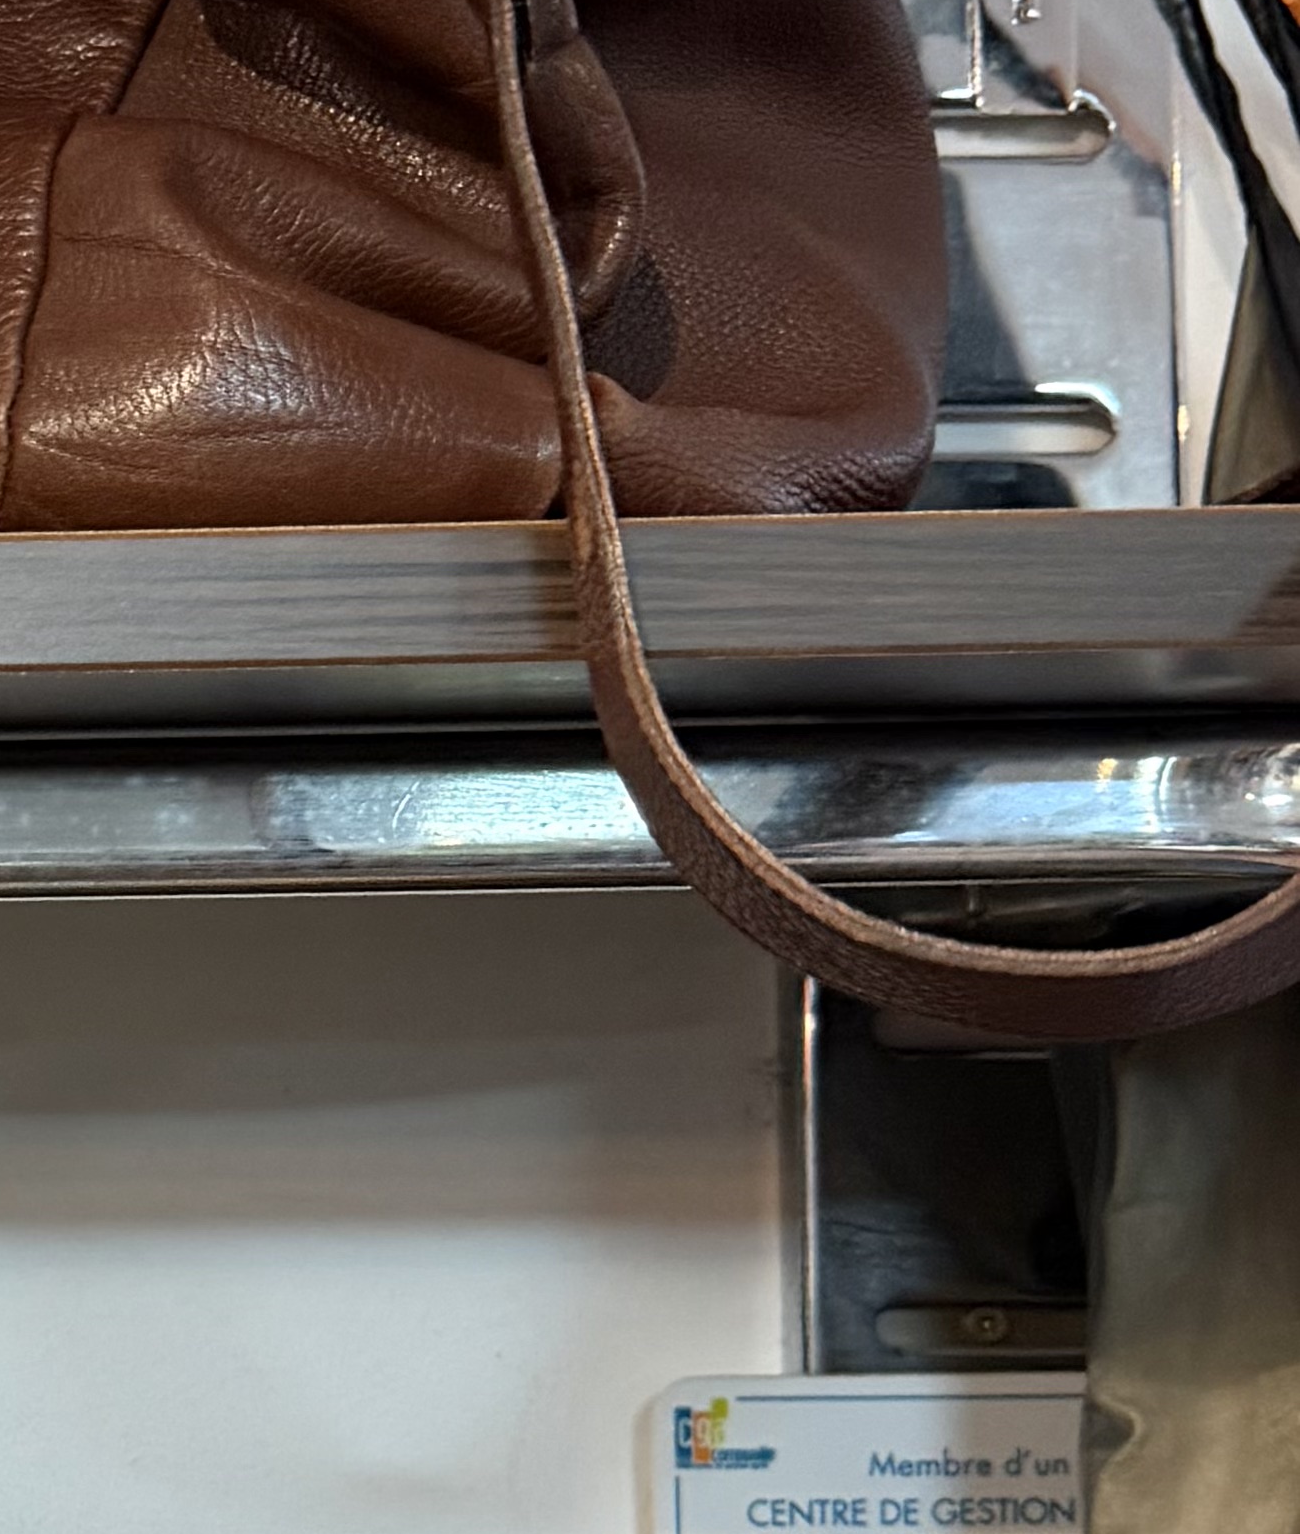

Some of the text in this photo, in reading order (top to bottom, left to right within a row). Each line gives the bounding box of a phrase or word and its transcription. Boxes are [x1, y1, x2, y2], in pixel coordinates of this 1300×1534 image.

[868, 1446, 1069, 1476] Membre d'un
[747, 1497, 1077, 1527] CENTRE DE GESTION
